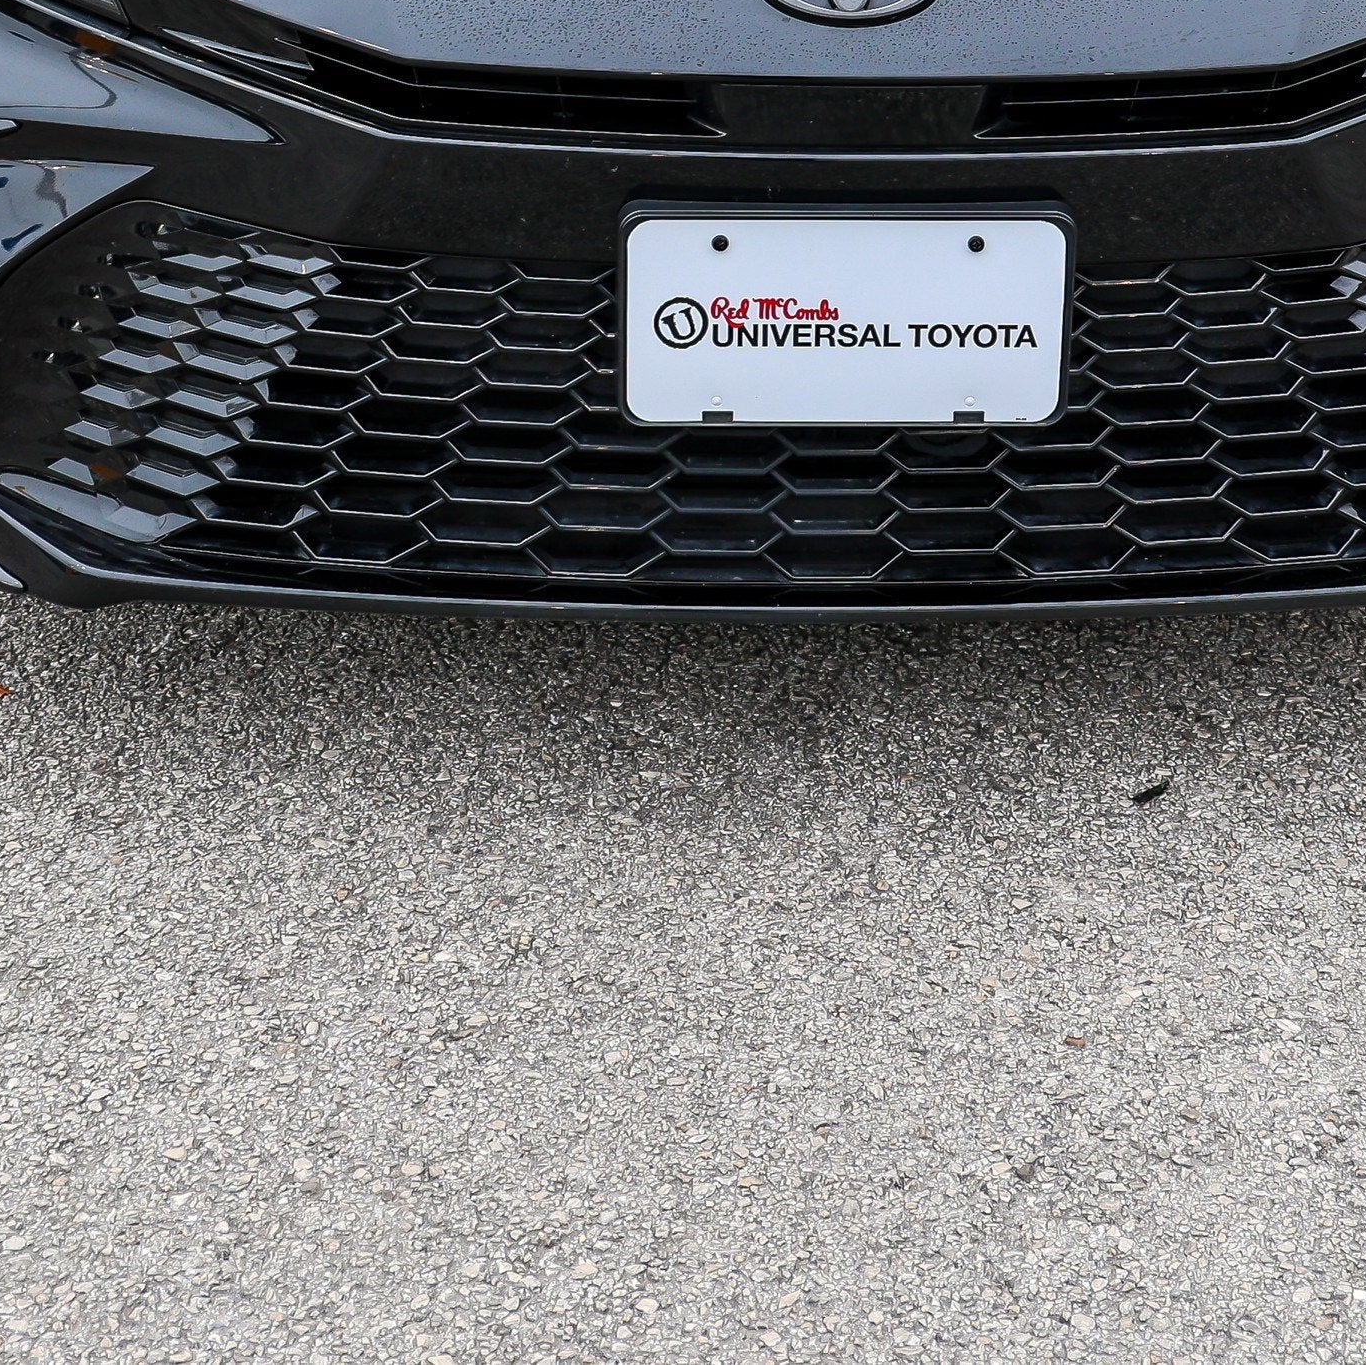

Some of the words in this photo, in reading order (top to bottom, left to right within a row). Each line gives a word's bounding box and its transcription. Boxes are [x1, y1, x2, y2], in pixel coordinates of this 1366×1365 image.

[711, 296, 750, 329] Red
[752, 297, 839, 321] McCombs
[712, 323, 901, 348] UNIVERSAL
[908, 323, 1038, 349] TOYOTA
